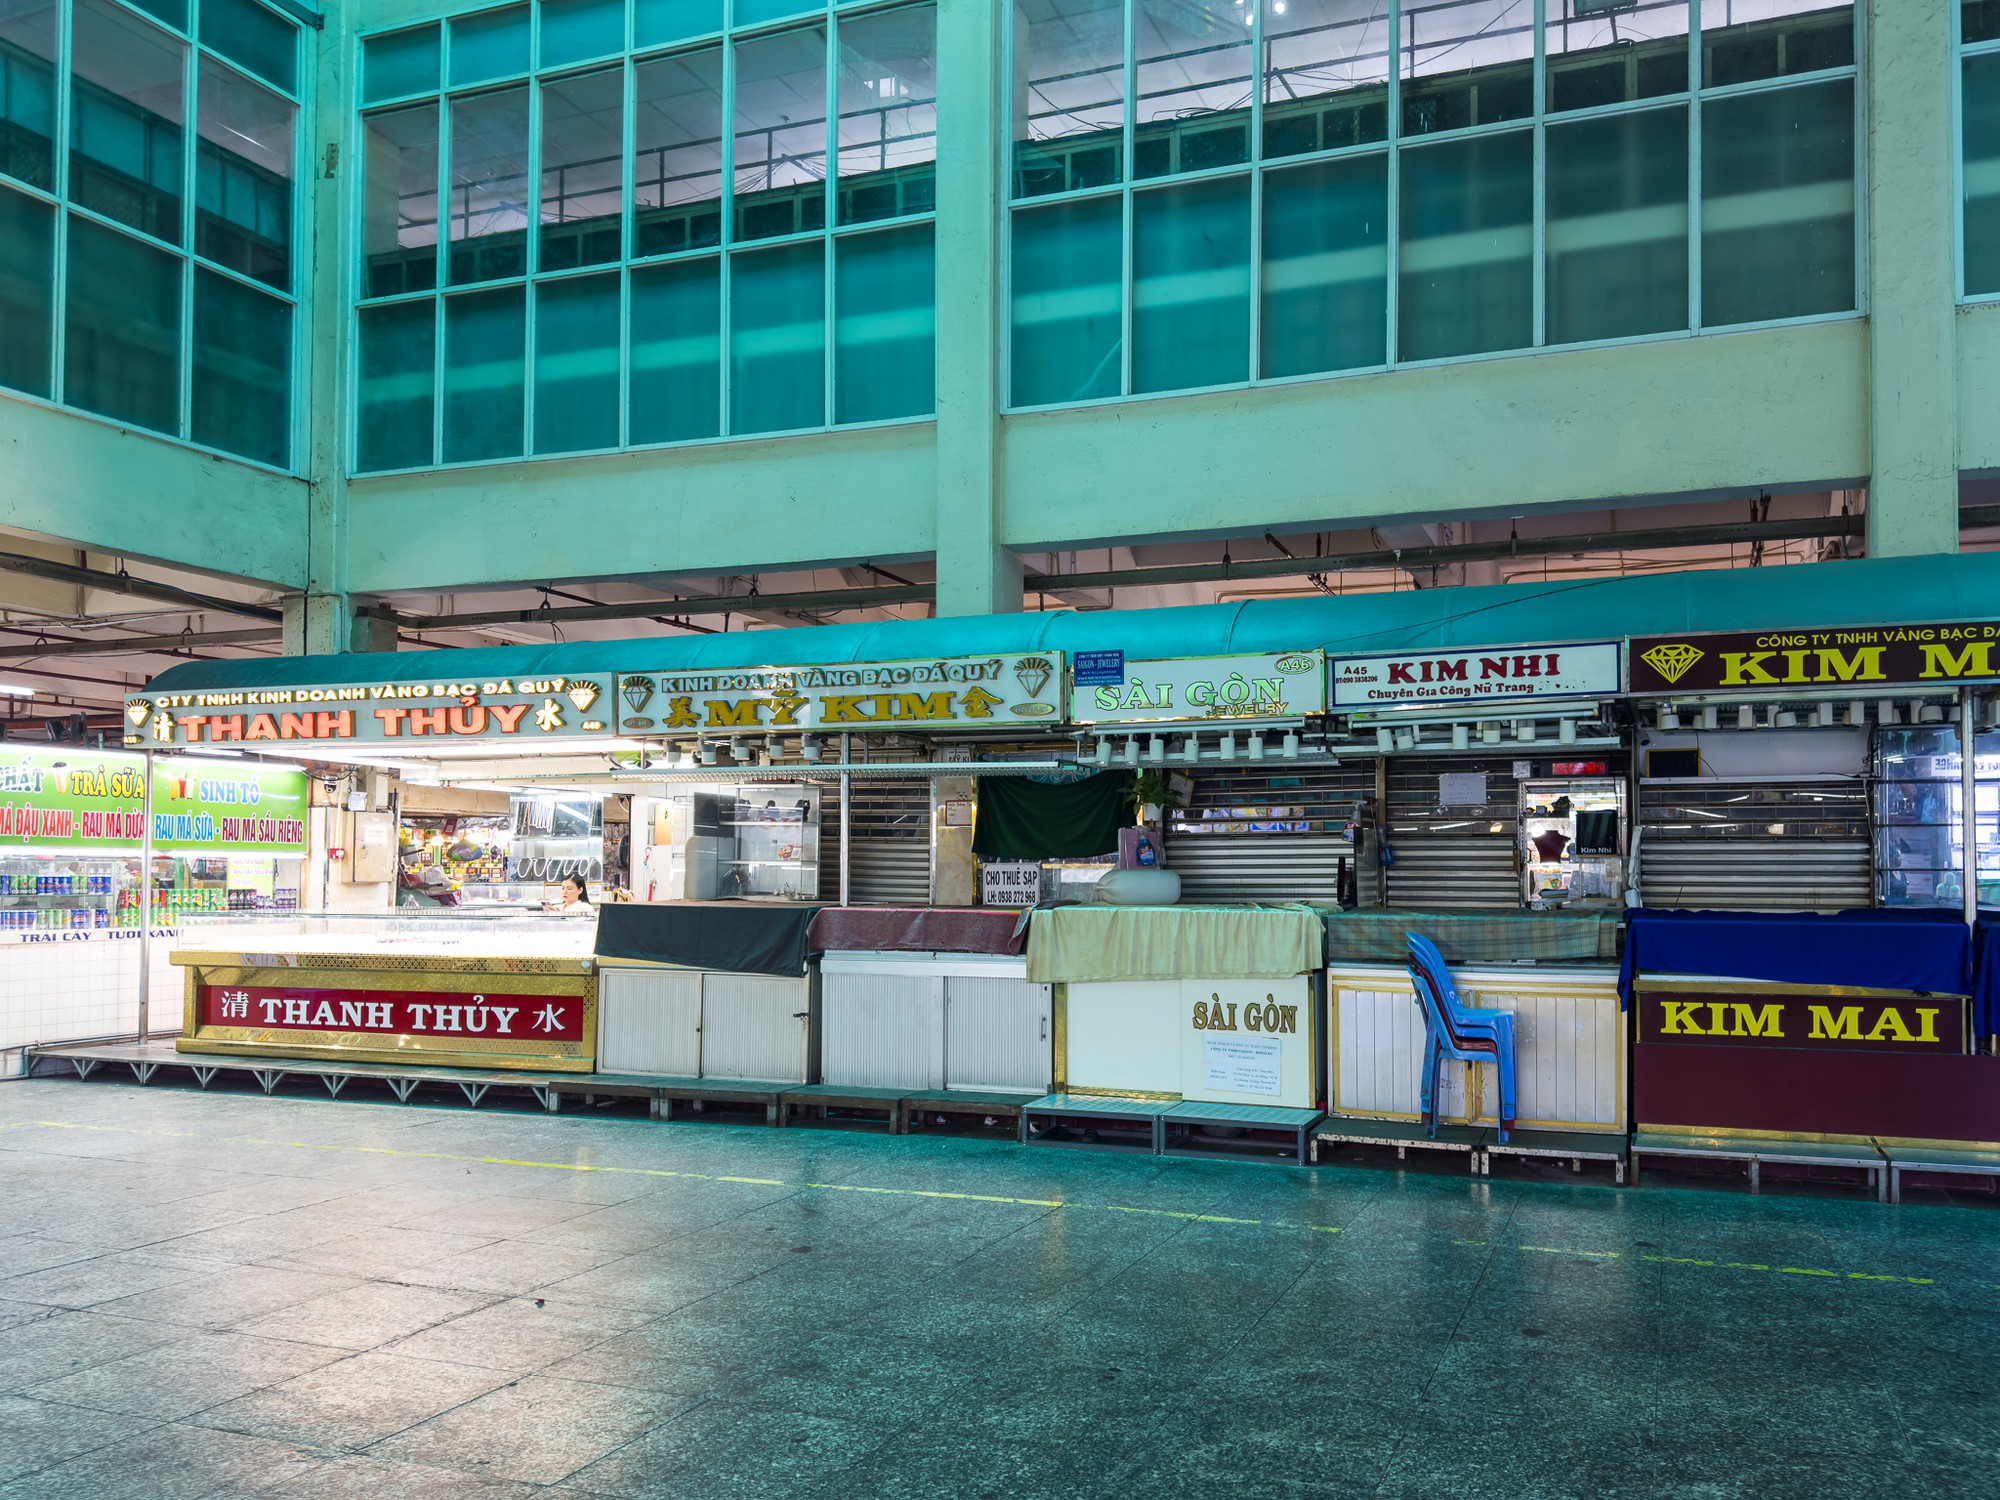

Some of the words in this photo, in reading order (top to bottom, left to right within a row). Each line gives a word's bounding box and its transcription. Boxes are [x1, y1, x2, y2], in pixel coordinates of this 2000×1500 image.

[1756, 633, 1807, 648] CÔNG
[1812, 634, 1830, 646] TY
[1836, 631, 1878, 645] TNHH
[1883, 627, 1935, 643] VÀNG
[1940, 626, 1977, 641] BẠC
[662, 677, 713, 693] KINH
[718, 673, 794, 691] DOANH
[798, 668, 858, 688] VÀNG
[862, 667, 911, 689] BẠC
[913, 662, 947, 683] ĐÁ
[949, 659, 1003, 683] QUÝ
[1280, 657, 1309, 671] A46
[1344, 666, 1368, 675] A45
[1387, 658, 1469, 685] KIM
[1479, 653, 1560, 680] NHI
[1719, 646, 1887, 686] KIM
[1918, 641, 2000, 679] M
[156, 695, 193, 708] CTY
[197, 692, 244, 706] TNHH
[248, 690, 292, 704] KINH
[296, 687, 366, 702] DOANH
[370, 684, 429, 699] VÀNG
[433, 683, 477, 698] BẠC
[482, 680, 511, 694] ĐÁ
[518, 677, 567, 694] QUÝ
[957, 686, 1004, 718] 金
[1095, 677, 1173, 711] SÀI
[1185, 672, 1284, 707] GÒN
[1367, 688, 1414, 701] Chuyên
[1440, 685, 1471, 698] Công
[1474, 682, 1492, 694] Nữ
[1495, 682, 1534, 694] Trang
[178, 710, 353, 742] THANH
[374, 696, 528, 736] THỦY
[535, 698, 563, 732] 水
[662, 696, 700, 728] 美
[704, 689, 808, 727] MỸ
[819, 691, 957, 723] KIM
[1206, 702, 1289, 716] JEWELRY
[71, 764, 107, 797] TRÀ
[111, 767, 144, 798] SỮA
[200, 780, 238, 804] SINH
[240, 773, 261, 804] TỐ
[15, 803, 39, 842] ĐẬU
[41, 810, 72, 836] XANH
[82, 811, 103, 838] RAU
[105, 807, 122, 838] MÁ
[125, 808, 144, 839] DỪA
[155, 815, 174, 840] RAU
[177, 811, 192, 840] MÁ
[195, 811, 213, 841] SỮA
[222, 817, 239, 841] RAU
[242, 814, 256, 842] MÁ
[278, 816, 303, 843] RIÊNG
[986, 871, 1000, 885] CHO
[1002, 867, 1021, 885] THUÊ
[1023, 871, 1037, 888] SẠP
[987, 891, 996, 903] LH:
[998, 891, 1012, 903] 0938
[1013, 891, 1024, 903] 272
[221, 991, 249, 1018] 清
[259, 998, 393, 1029] THANH
[407, 995, 519, 1033] THỦY
[532, 1004, 565, 1033] 水
[1192, 993, 1237, 1031] SÀI
[1244, 993, 1297, 1033] GÒN
[1660, 1001, 1785, 1037] KIM
[1808, 1005, 1940, 1042] MAI
